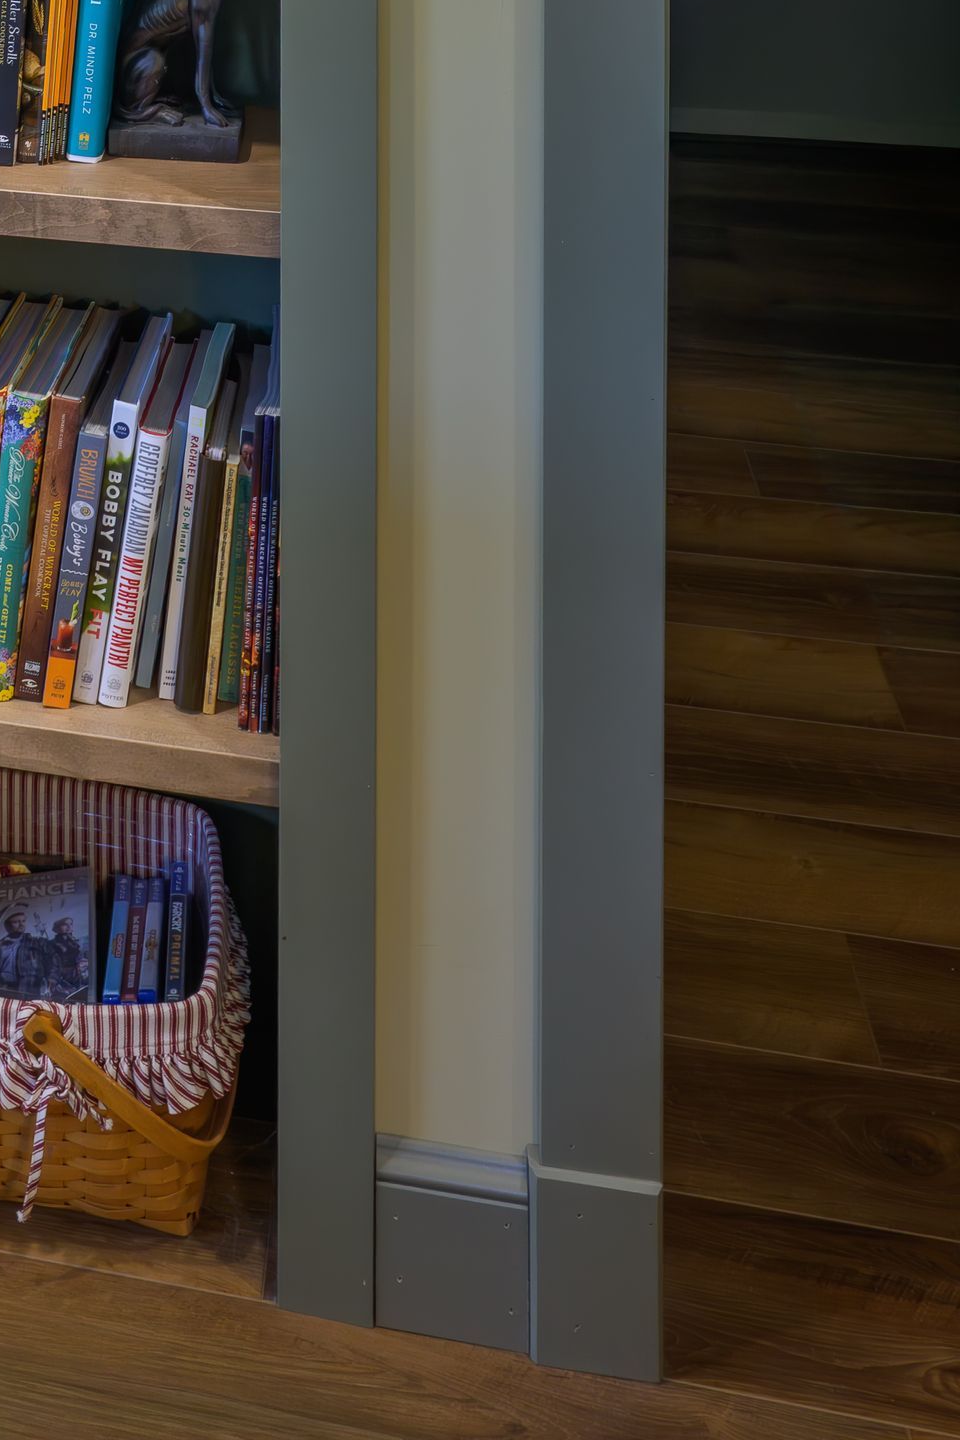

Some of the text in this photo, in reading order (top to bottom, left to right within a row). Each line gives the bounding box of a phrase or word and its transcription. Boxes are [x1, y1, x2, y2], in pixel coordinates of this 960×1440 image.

[6, 25, 20, 65] Scrolls
[82, 22, 98, 115] DR. MINDY PELZ
[67, 447, 99, 567] BRUNCH Bobby's
[124, 441, 161, 557] GEOFFREY ZAKARIAN
[176, 435, 200, 583] RACHAEL RAY 30-Minute Meals
[3, 563, 13, 593] COME
[87, 470, 122, 640] BOBBY FLAY FIT
[0, 607, 10, 627] GET
[107, 554, 144, 671] MY PERFECT PANTRY
[169, 933, 183, 981] PRIMAL
